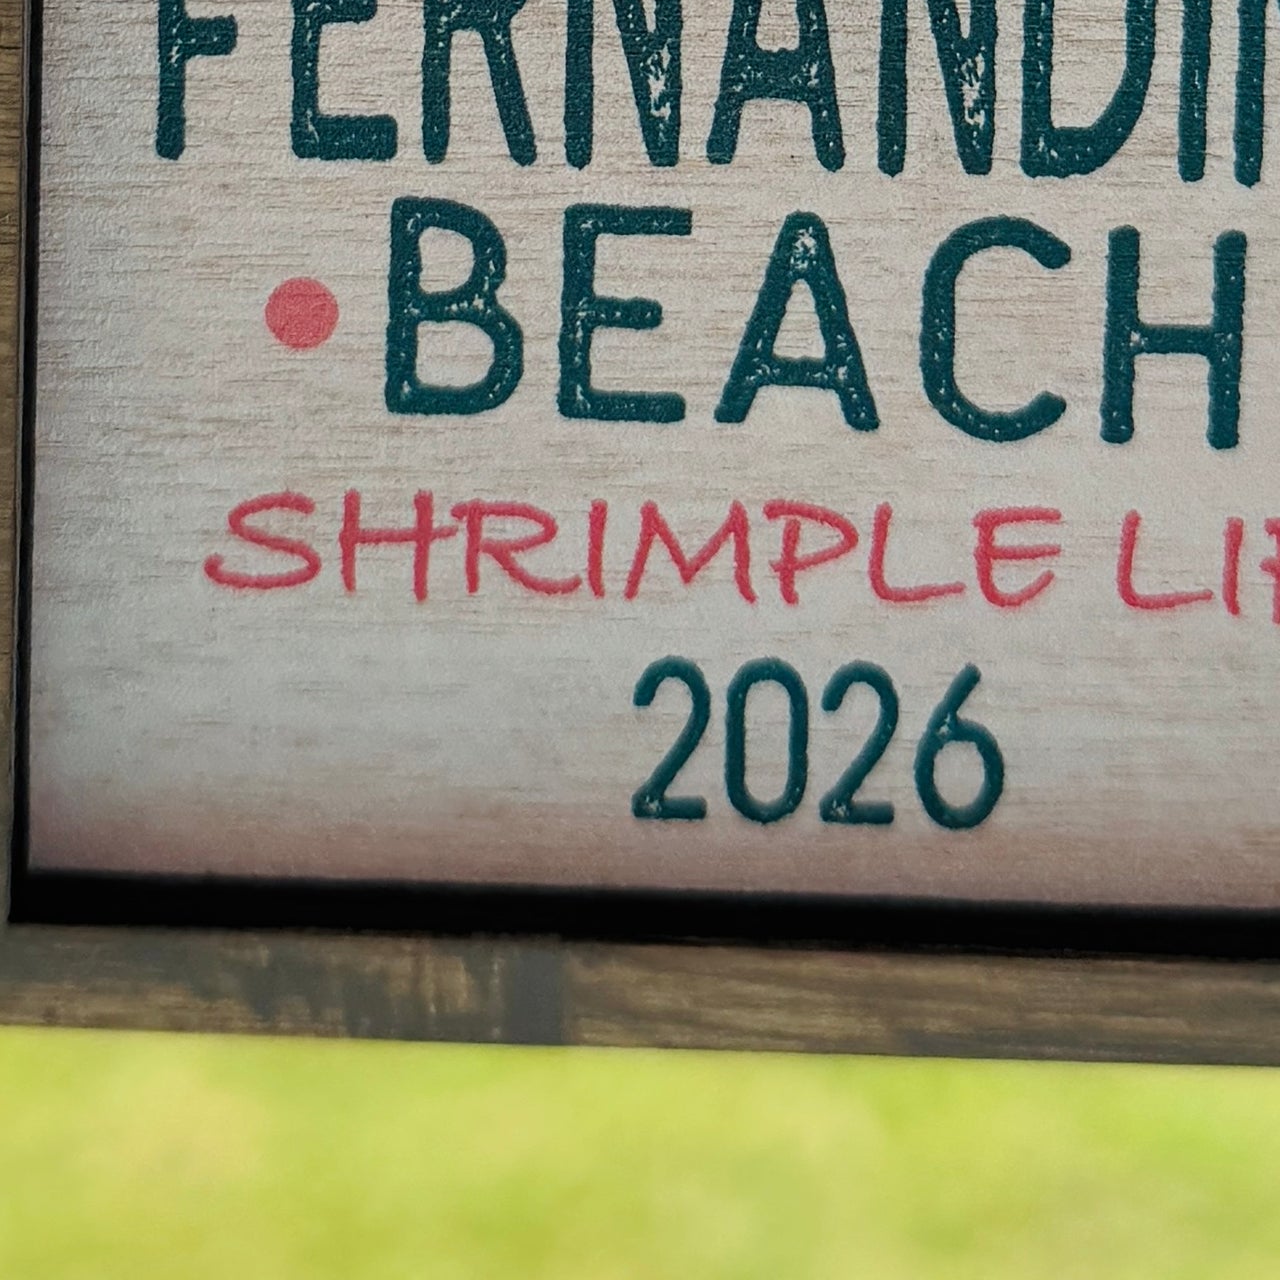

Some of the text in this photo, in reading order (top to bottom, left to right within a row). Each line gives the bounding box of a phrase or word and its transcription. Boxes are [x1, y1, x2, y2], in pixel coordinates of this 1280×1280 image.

[383, 195, 1249, 451] BEACH
[203, 490, 1063, 610] SHRIMPLE
[630, 656, 1006, 832] 2026
